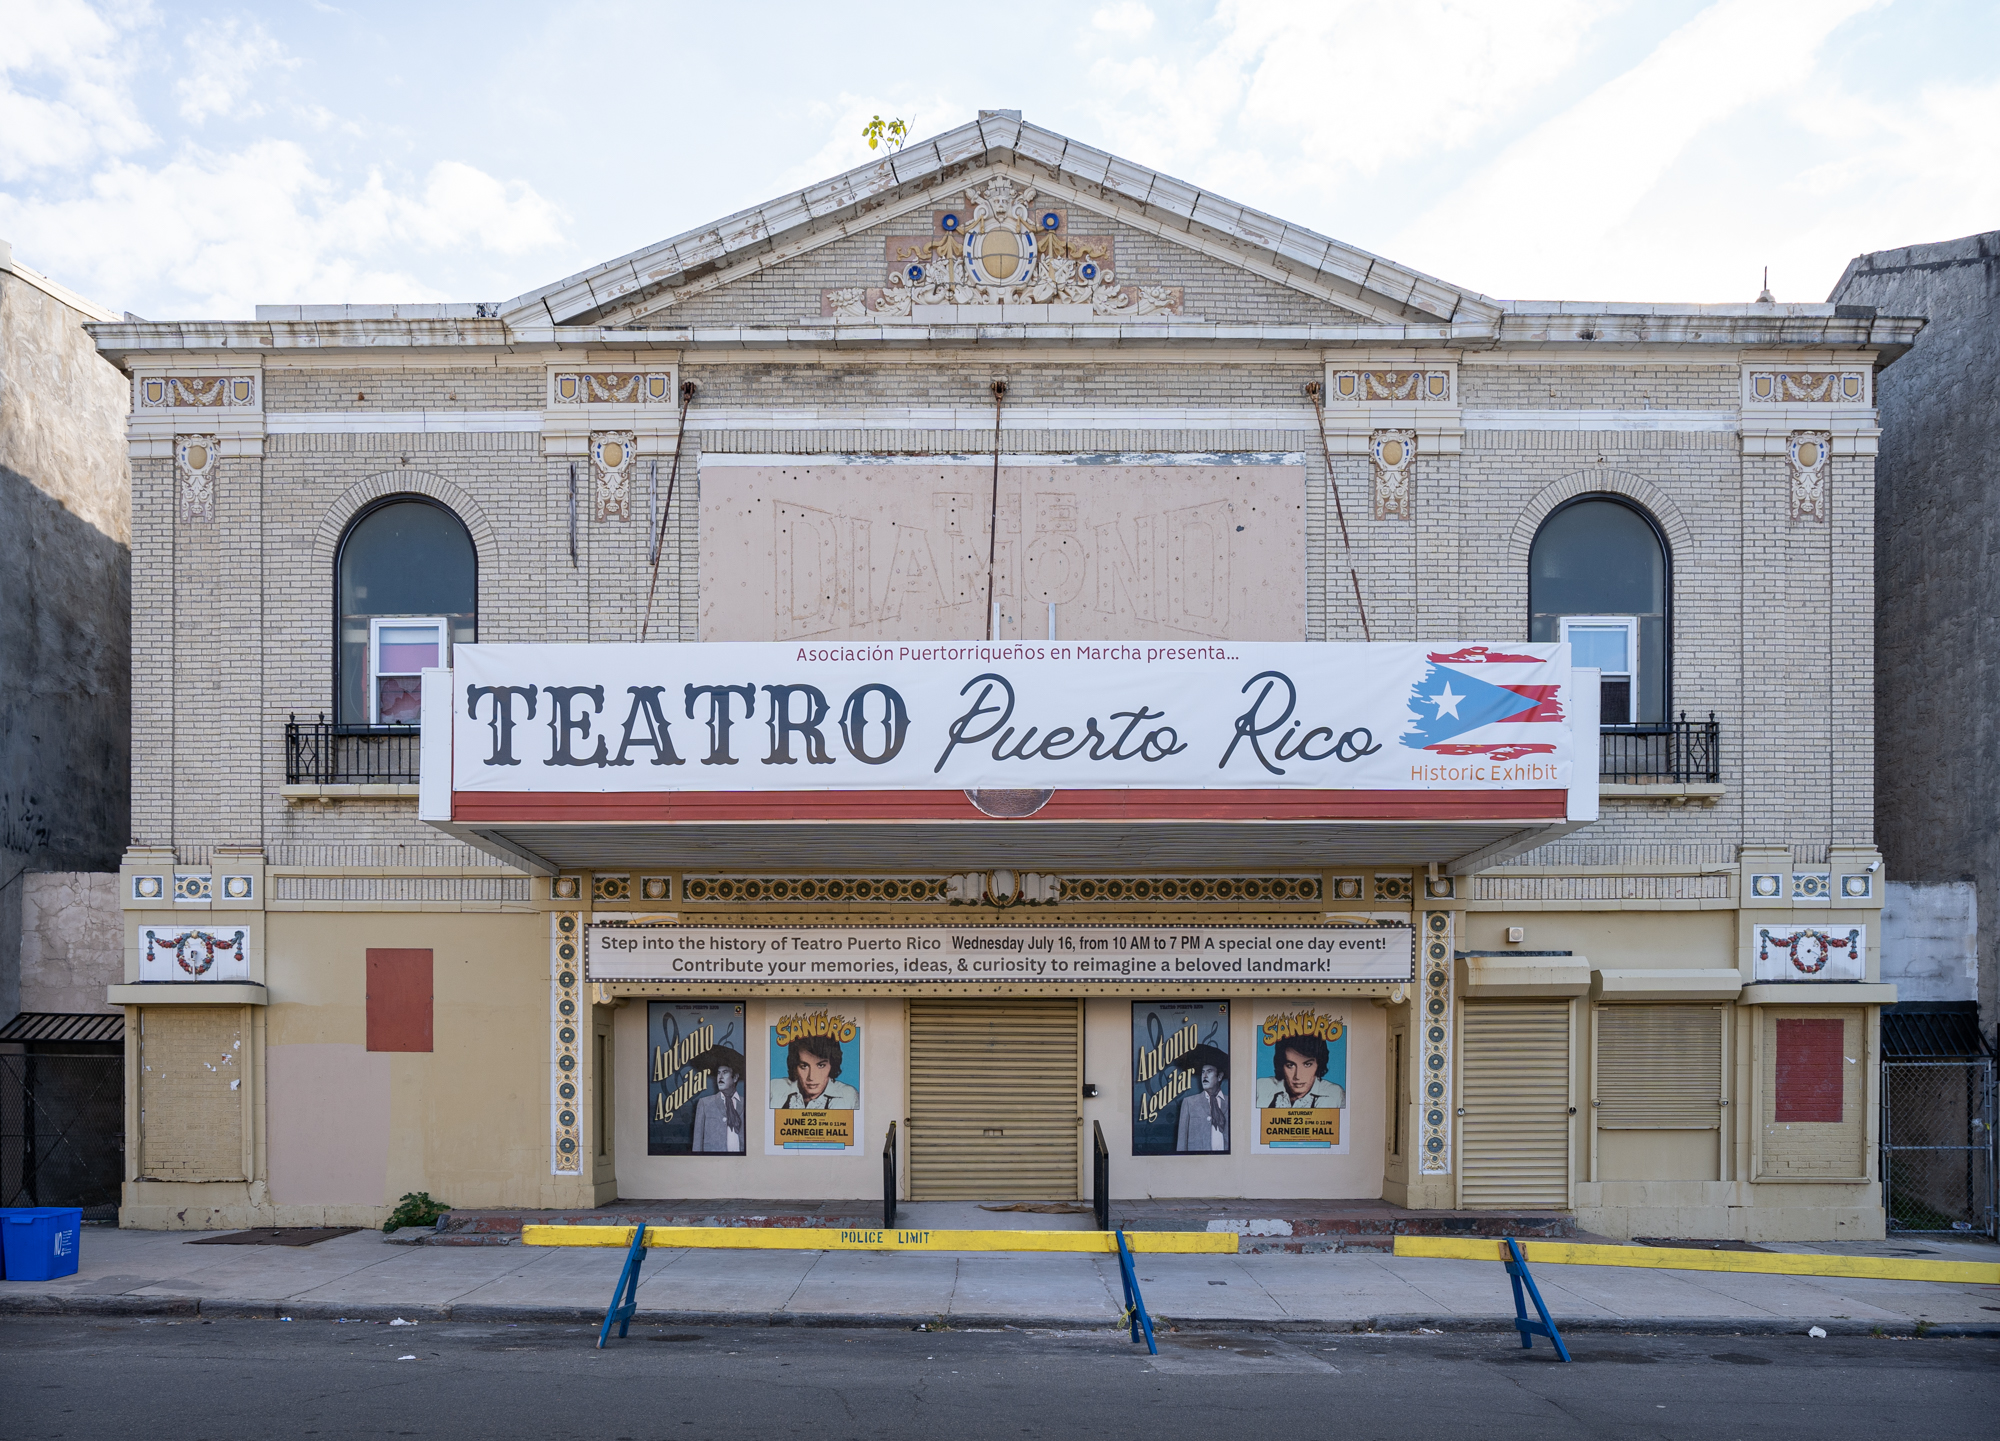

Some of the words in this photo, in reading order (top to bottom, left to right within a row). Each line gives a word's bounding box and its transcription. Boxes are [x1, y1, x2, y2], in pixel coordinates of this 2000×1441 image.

[773, 498, 1231, 641] DIAMOND
[797, 645, 893, 661] Asociación
[899, 643, 1045, 663] Puertorriqueños
[1051, 648, 1070, 660] en
[1077, 645, 1141, 660] Marcha
[1148, 646, 1239, 663] presenta...
[466, 682, 912, 768] TEATRO
[934, 672, 1188, 774] Puerto
[1219, 670, 1383, 775] Rico
[1411, 764, 1485, 781] Historic
[1491, 763, 1557, 781] Exhibit
[601, 936, 638, 953] Step
[643, 936, 673, 950] into
[679, 936, 705, 950] the
[710, 936, 766, 953] history
[771, 936, 788, 950] of
[791, 936, 843, 950] Teatro
[848, 936, 902, 950] Puerto
[907, 936, 941, 950] Rico
[952, 936, 1025, 953] Wednesday
[1028, 936, 1054, 953] July
[1058, 936, 1075, 952] 16,
[1080, 936, 1108, 950] from
[1112, 936, 1127, 950] 10
[1130, 936, 1150, 950] AM
[1154, 936, 1166, 950] to
[1169, 936, 1178, 950] 7
[1181, 936, 1200, 950] PM
[1205, 936, 1215, 950] A
[1219, 936, 1272, 953] special
[1276, 936, 1304, 950] one
[1308, 936, 1335, 953] day
[1339, 936, 1386, 950] event!
[672, 957, 763, 973] Contribute
[768, 957, 807, 976] your
[812, 957, 899, 975] memories,
[904, 957, 953, 975] ideas,
[957, 957, 969, 972] &
[973, 957, 1046, 975] curiosity
[1051, 957, 1069, 972] to
[1073, 957, 1157, 976] reimagine
[1161, 957, 1171, 972] a
[1176, 957, 1242, 972] beloved
[1247, 957, 1331, 972] landmark!
[776, 1009, 858, 1047] SANDRO
[1262, 1008, 1344, 1046] SANDRO
[653, 1017, 714, 1082] Antonio
[1137, 1016, 1198, 1082] Antonio
[654, 1067, 711, 1123] Aguilar
[1138, 1067, 1196, 1123] Aguilar
[783, 1118, 806, 1126] JUNE
[807, 1118, 817, 1126] 23
[1266, 1127, 1310, 1135] CARNEGIE
[1312, 1127, 1334, 1135] HALL
[1269, 1117, 1292, 1125] JUNE
[1293, 1117, 1303, 1125] 23
[780, 1128, 824, 1136] CARNEGIE
[841, 1231, 884, 1243] POLICE
[898, 1232, 930, 1244] LIMIT
